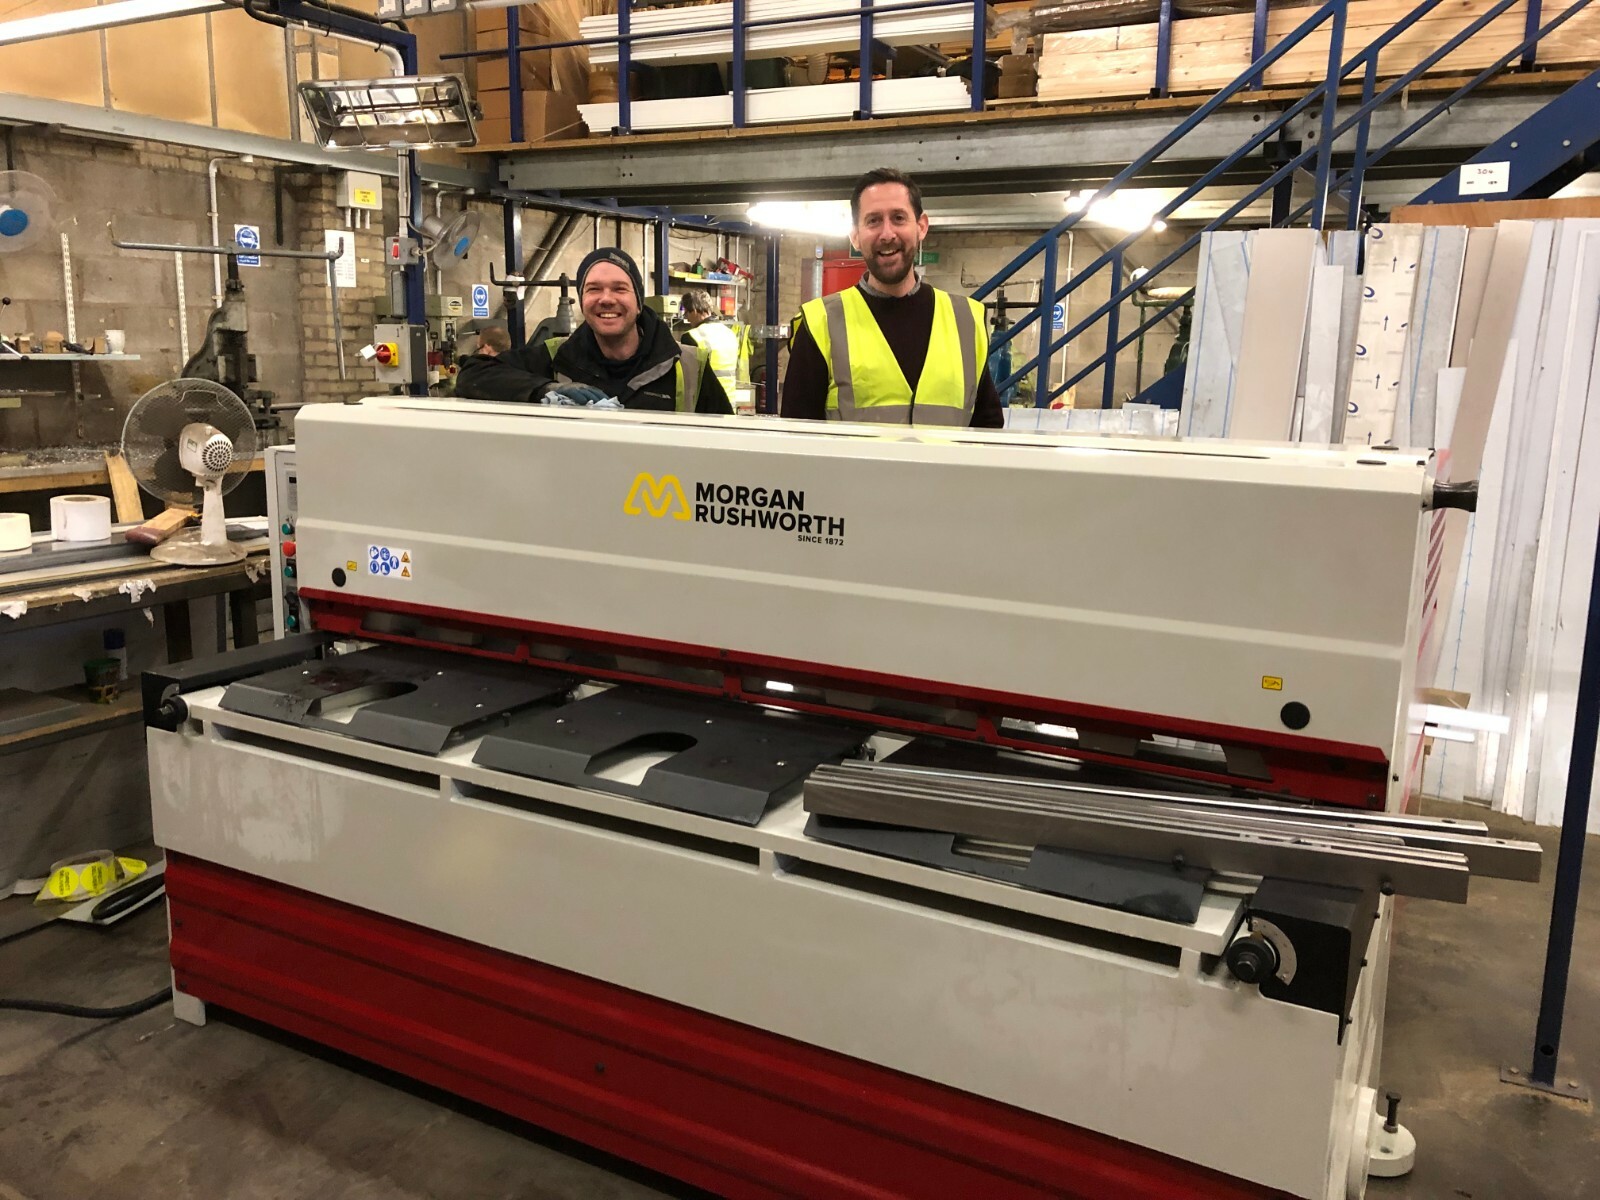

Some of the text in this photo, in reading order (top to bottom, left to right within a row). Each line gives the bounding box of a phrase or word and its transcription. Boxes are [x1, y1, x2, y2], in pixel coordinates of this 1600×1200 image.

[696, 482, 804, 511] MORGAN
[695, 504, 844, 537] RUSHWORTH
[798, 535, 844, 546] SINCE 1872
